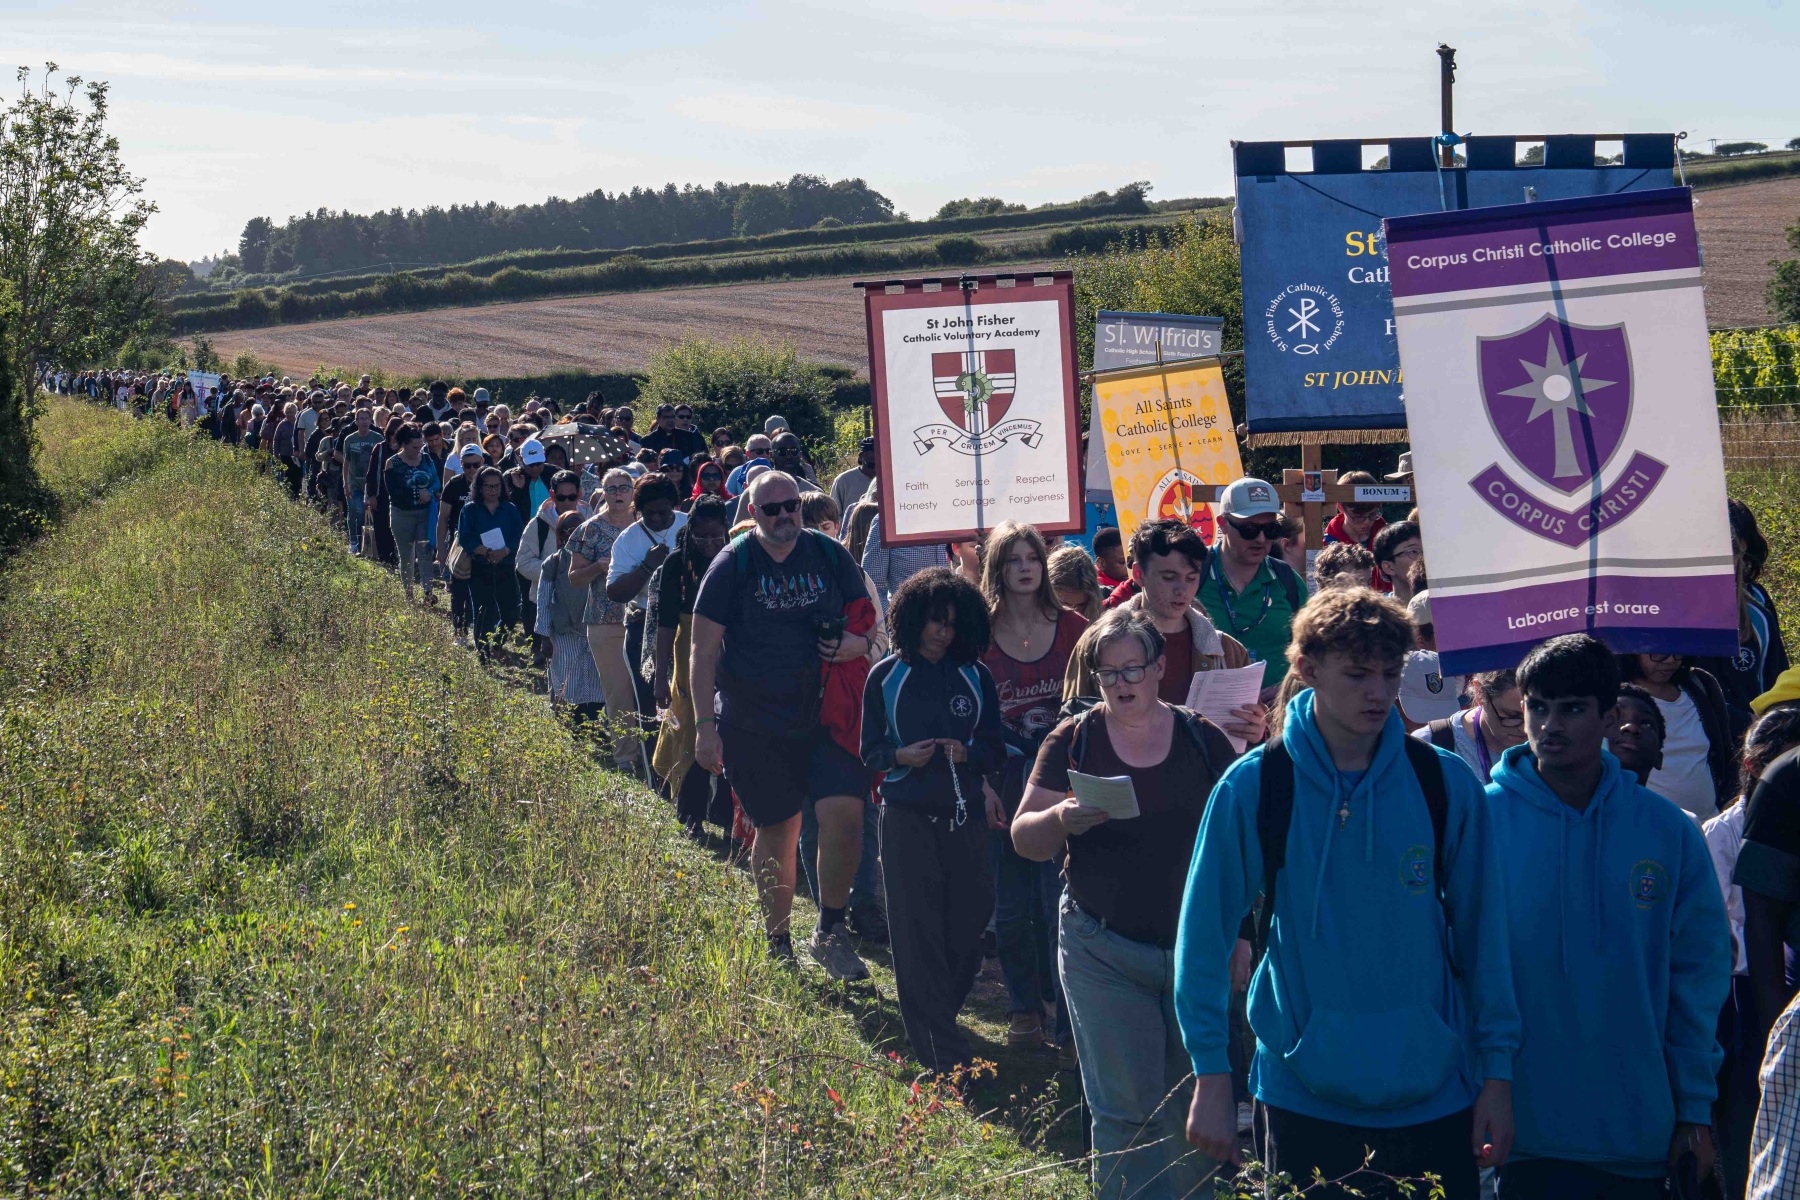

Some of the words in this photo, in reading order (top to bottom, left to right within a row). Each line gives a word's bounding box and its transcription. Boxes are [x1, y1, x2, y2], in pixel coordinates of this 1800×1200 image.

[1346, 231, 1378, 256] St
[1407, 251, 1467, 269] Corpus
[1472, 244, 1525, 261] Christi
[1530, 236, 1602, 255] Catholic
[1607, 230, 1677, 251] College
[1287, 283, 1327, 296] Catholic
[1266, 292, 1286, 318] Fisher
[1327, 294, 1344, 317] High
[926, 319, 939, 329] St
[943, 317, 973, 329] John
[977, 315, 1015, 326] Fisher
[903, 333, 941, 343] Catholic
[943, 331, 991, 342] Voluntary
[994, 328, 1040, 340] Academy
[1105, 318, 1127, 346] St.
[1134, 326, 1211, 347] Wilfrid's
[1267, 320, 1281, 343] John
[1324, 320, 1344, 350] School
[1126, 348, 1138, 356] High
[1278, 341, 1288, 352] St
[1304, 372, 1329, 386] ST
[1333, 370, 1392, 389] JOHN
[1136, 401, 1152, 414] All
[1157, 397, 1192, 411] Saints
[998, 424, 1033, 436] VINCEMUS
[1117, 418, 1168, 437] Catholic
[1172, 412, 1217, 430] College
[961, 440, 996, 450] CRUCEM
[1198, 437, 1222, 445] LEARN
[955, 478, 990, 487] Service
[1016, 474, 1055, 484] Respect
[1159, 477, 1172, 491] ALL
[905, 482, 929, 491] Faith
[1363, 488, 1399, 496] BONUM
[952, 496, 995, 507] Courage
[1009, 493, 1064, 503] Forgiveness
[1487, 481, 1565, 535] CORPUS
[1578, 470, 1651, 531] CHRISTI
[899, 501, 937, 512] Honesty
[1507, 608, 1579, 630] Laborare
[1585, 600, 1609, 615] est
[1614, 602, 1660, 615] orare
